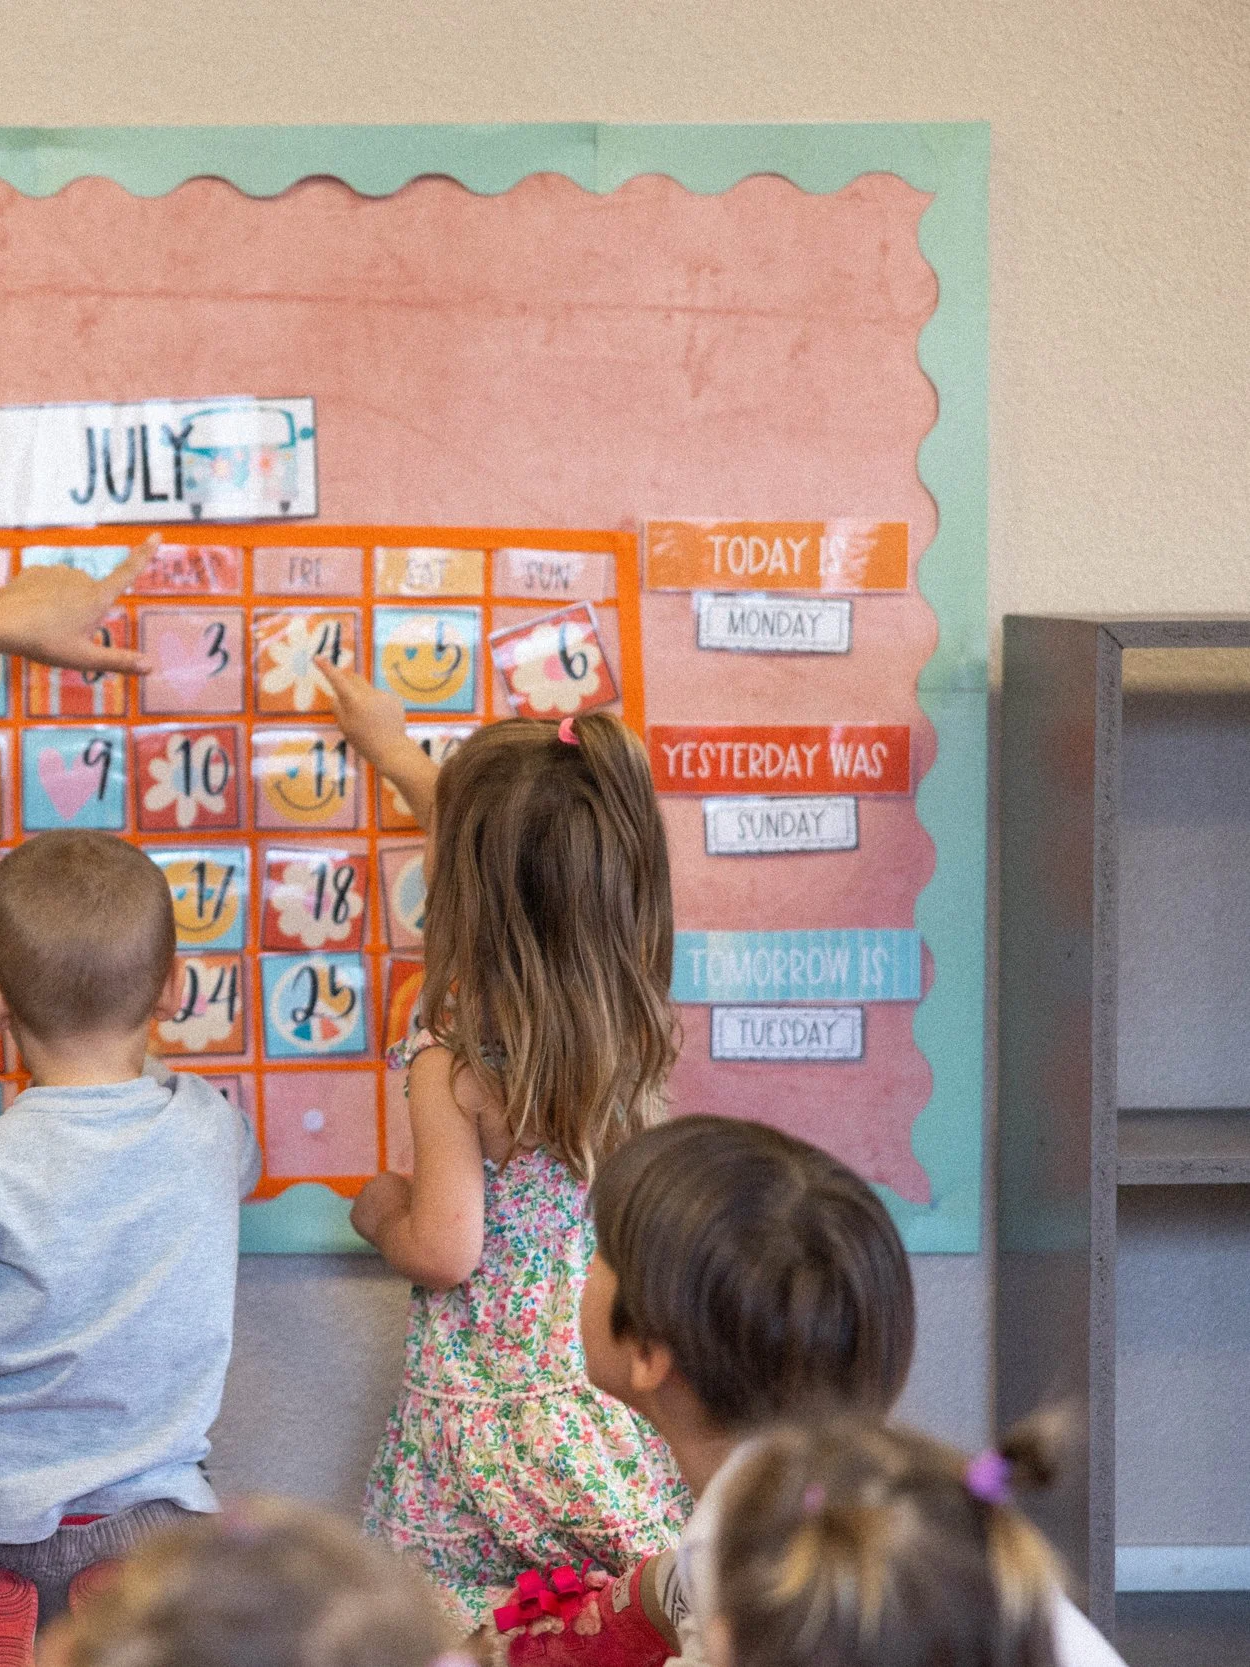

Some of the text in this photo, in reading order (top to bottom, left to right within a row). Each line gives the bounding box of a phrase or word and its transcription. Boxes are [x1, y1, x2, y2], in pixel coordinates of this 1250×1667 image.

[70, 424, 194, 505] JULY
[288, 557, 324, 588] FRI
[524, 560, 571, 591] SUN
[708, 535, 848, 577] TODAY IS
[204, 622, 231, 678] 3
[314, 619, 343, 667] 4
[430, 621, 462, 679] 5
[558, 622, 588, 681] 6
[727, 609, 822, 639] MONDAY
[83, 738, 114, 801] 9
[173, 738, 230, 797] 10
[309, 738, 350, 800] 11
[661, 741, 889, 780] YESTERDAY WAS
[736, 811, 826, 841] SUNDAY
[188, 861, 236, 921] 17
[310, 862, 356, 925] 18
[172, 964, 240, 1024] 24
[689, 945, 889, 987] TOMORROW IS
[291, 964, 357, 1026] 25
[740, 1018, 837, 1048] TUESDAY
